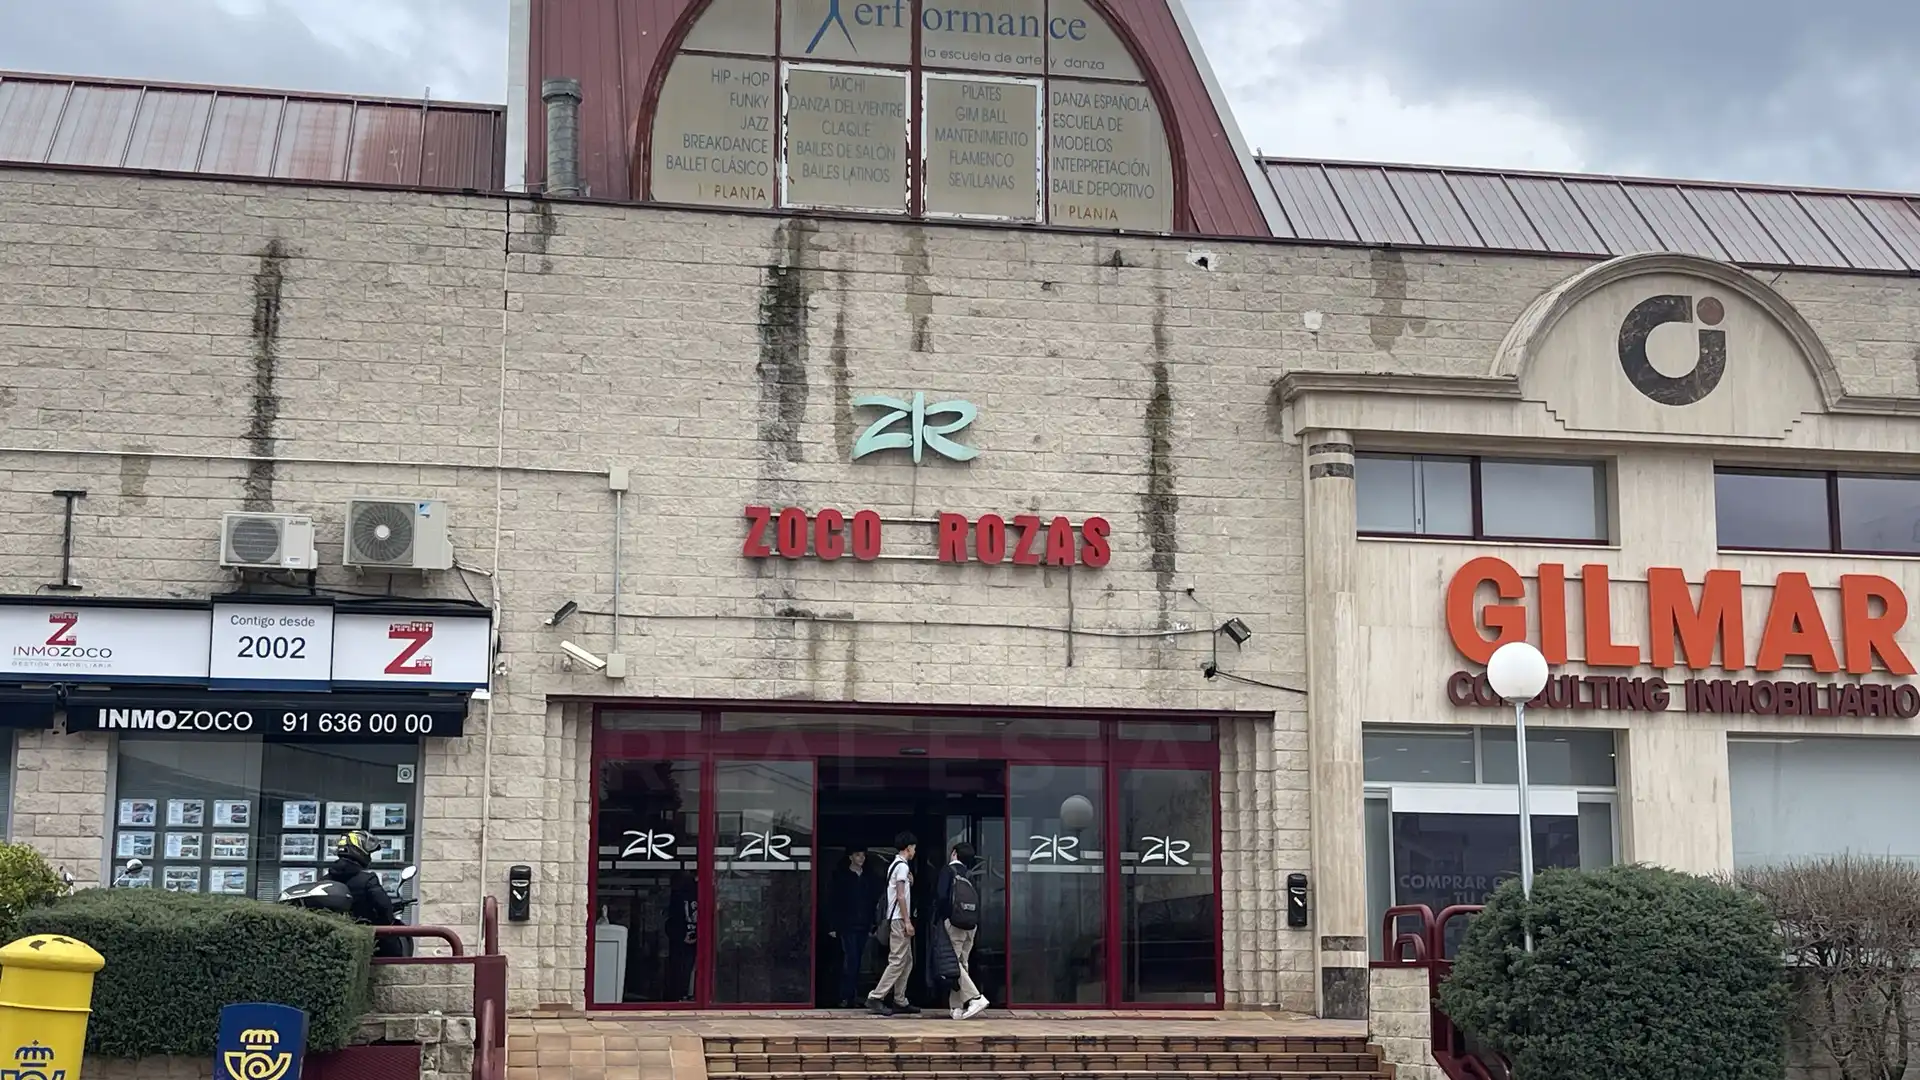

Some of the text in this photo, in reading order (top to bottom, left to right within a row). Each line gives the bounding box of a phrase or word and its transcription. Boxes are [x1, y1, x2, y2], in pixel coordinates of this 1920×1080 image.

[803, 0, 1087, 53] erformance
[924, 46, 936, 58] la
[940, 50, 991, 62] escuela
[995, 53, 1011, 63] de
[1016, 56, 1042, 65] arte
[1064, 57, 1105, 70] danza
[711, 68, 731, 84] HIP
[742, 71, 770, 87] HOP
[828, 76, 866, 93] TAICHI
[730, 92, 769, 109] FUNKY
[962, 85, 1002, 101] PILATES
[1053, 92, 1150, 112] DANZA ESPAÑOLA
[790, 95, 904, 118] DANZA DEL VIENTRE
[955, 106, 1008, 124] GIM BALL
[740, 115, 769, 132] JAZZ
[1053, 113, 1123, 132] ESCUELA DE
[682, 133, 768, 154] BREAKDANCE
[935, 127, 1029, 147] MANTENIMIENTO
[1053, 135, 1113, 153] MODELOS
[796, 140, 834, 157] BAILES
[837, 143, 852, 158] DE
[949, 149, 1015, 168] FLAMENCO
[666, 154, 768, 176] BALLET CLÁSICO
[802, 163, 891, 183] BAILES LATINOS
[1053, 157, 1151, 177] INTERPRETACIÓN
[949, 171, 1015, 190] SEVILLANAS
[1053, 178, 1155, 199] BAILE DEPORTIVO
[715, 184, 767, 201] PLANTA
[742, 505, 1111, 568] ZOCO ROZAS
[230, 614, 315, 628] Contigo desde
[1446, 556, 1918, 675] GILMAR
[13, 645, 113, 659] INMOZOCO
[237, 636, 306, 659] 2002
[1447, 670, 1920, 718] COULTING INMOBILIARIO
[98, 708, 433, 733] INMOZOCO 91 636 00 00
[1400, 875, 1487, 889] COMPRAR
[1454, 891, 1475, 905] TU
